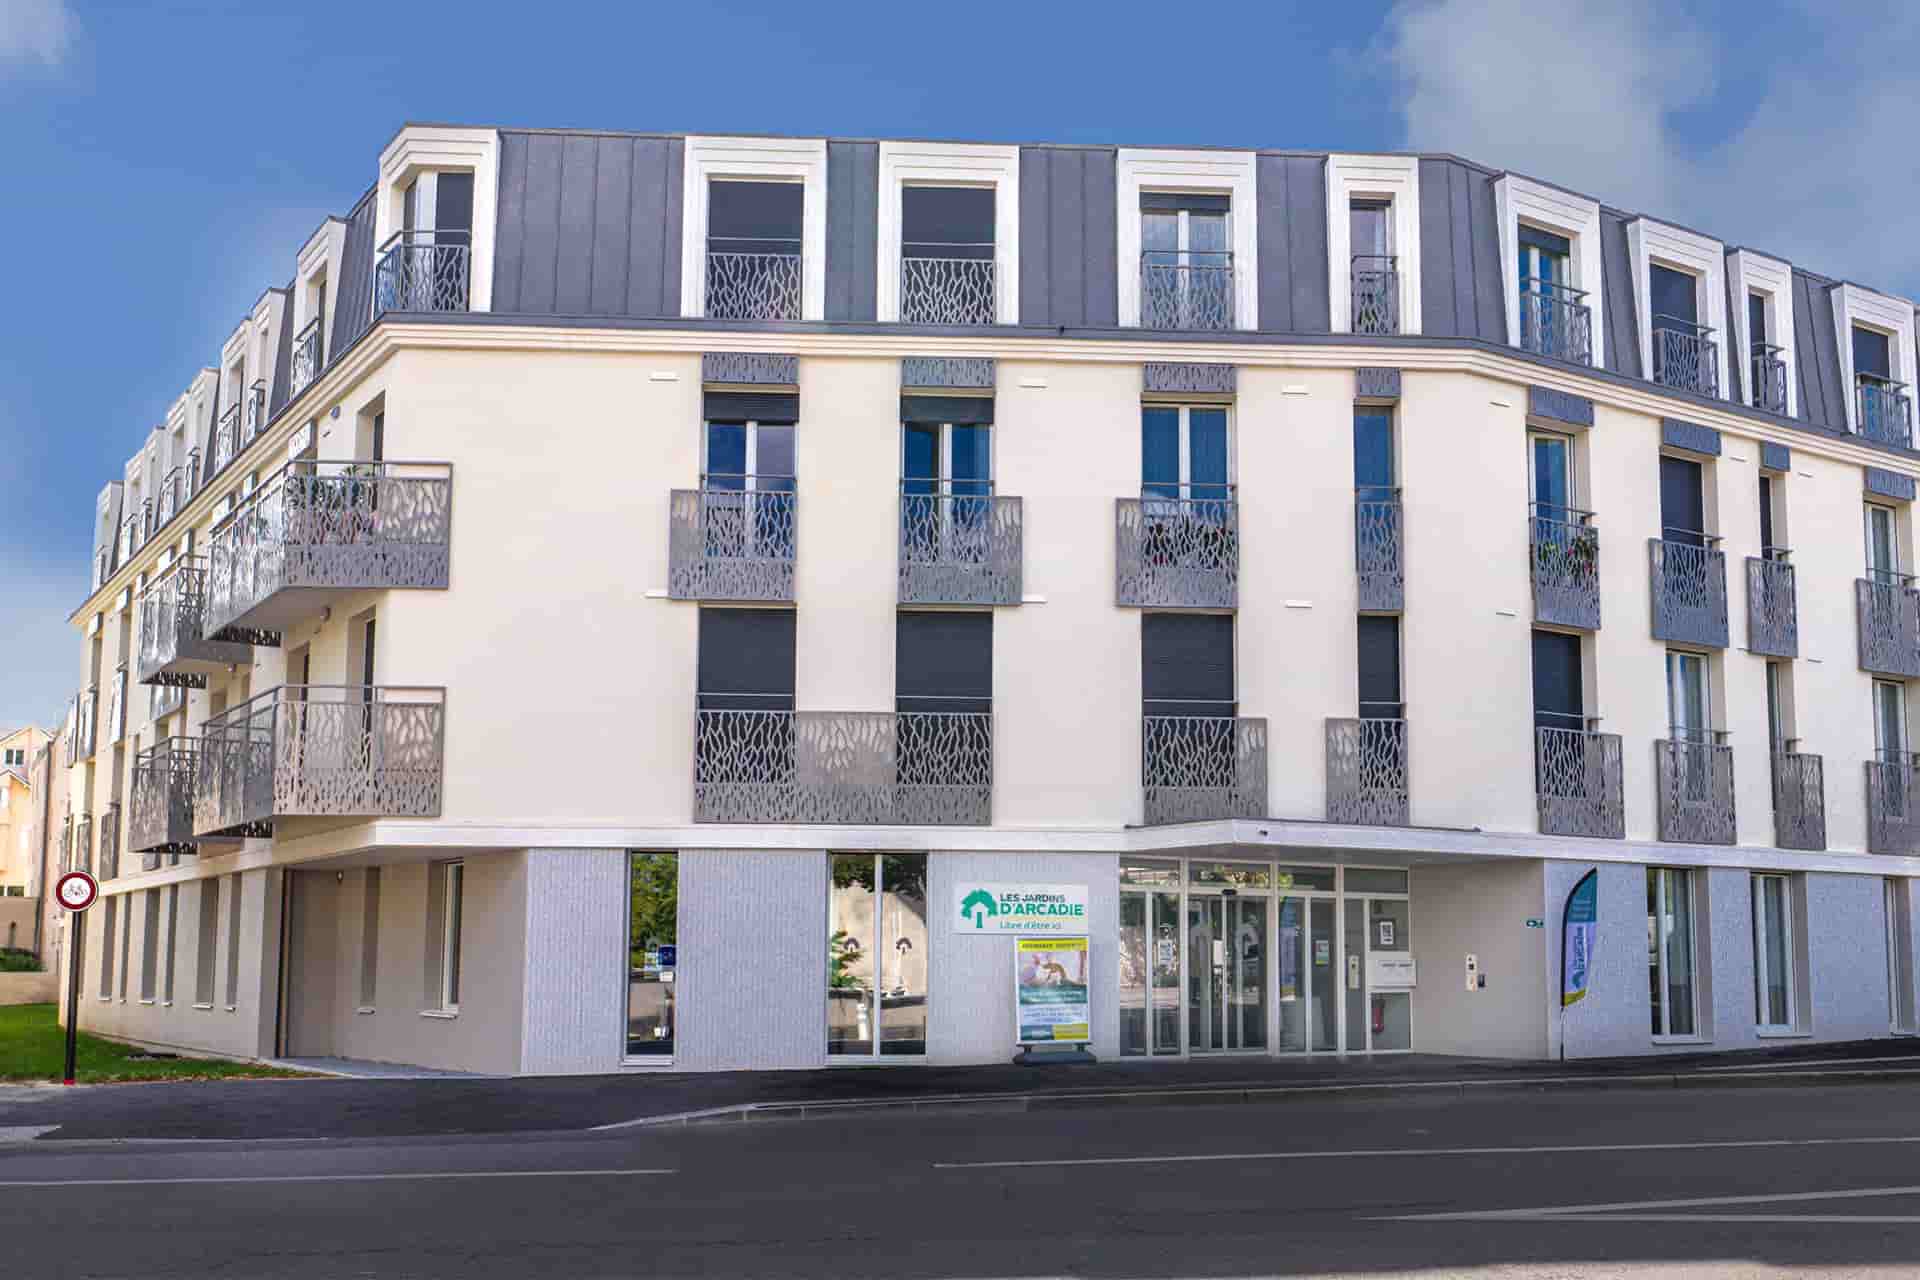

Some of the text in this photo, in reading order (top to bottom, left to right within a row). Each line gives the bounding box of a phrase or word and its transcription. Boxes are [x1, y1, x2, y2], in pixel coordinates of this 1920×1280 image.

[1000, 893, 1065, 903] LES JARDINS
[1000, 903, 1084, 916] D'ARCADIE
[1000, 919, 1022, 929] Libre
